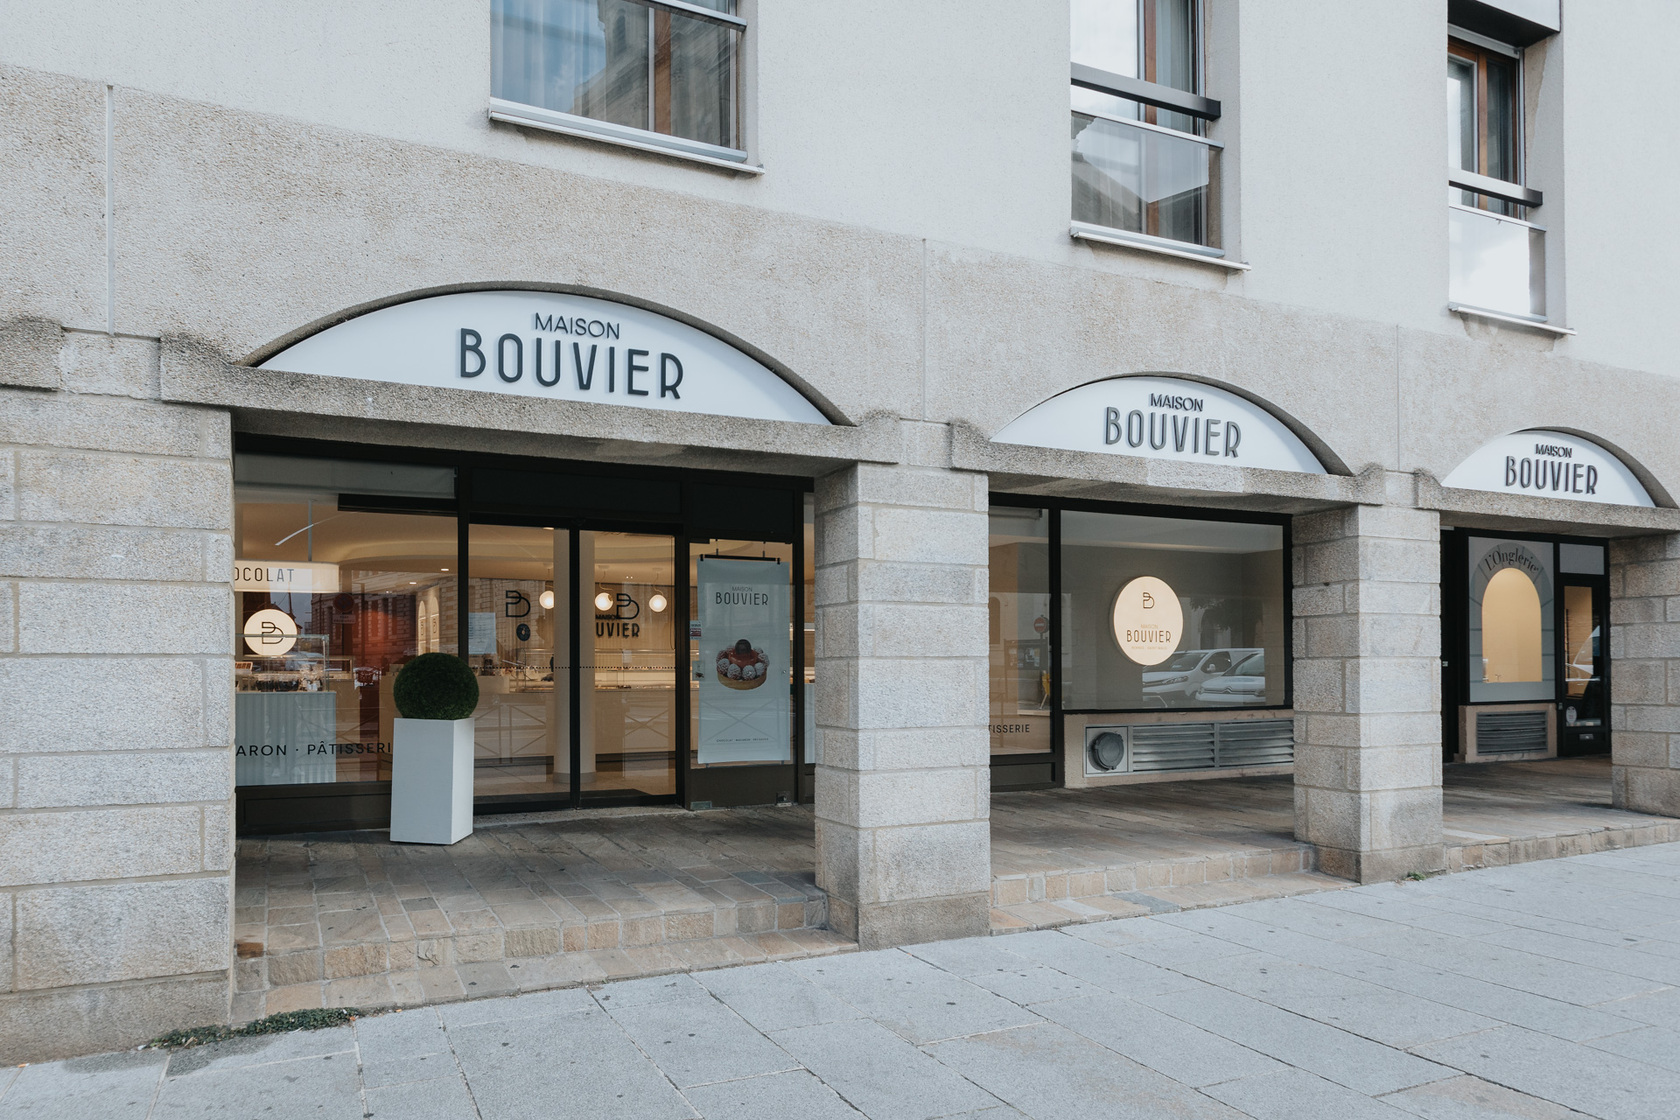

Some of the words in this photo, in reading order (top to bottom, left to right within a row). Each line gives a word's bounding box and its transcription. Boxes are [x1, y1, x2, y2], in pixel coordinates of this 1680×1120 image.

[535, 312, 620, 340] MAISON
[460, 328, 684, 400] BOUVIER
[1150, 393, 1204, 412] MAISON
[1105, 406, 1242, 458] BOUVIER
[1535, 443, 1573, 458] MAISON
[1505, 455, 1598, 495] BOUVIER
[1484, 547, 1540, 572] L'Onglerie
[234, 566, 295, 582] OCOLAT
[715, 591, 769, 606] BOUVIER
[595, 621, 640, 637] UVIER
[1126, 629, 1172, 643] BOUVIER
[988, 723, 1030, 733] TISSERIE
[235, 744, 287, 757] ARON
[307, 740, 391, 755] PÂTISSERI
